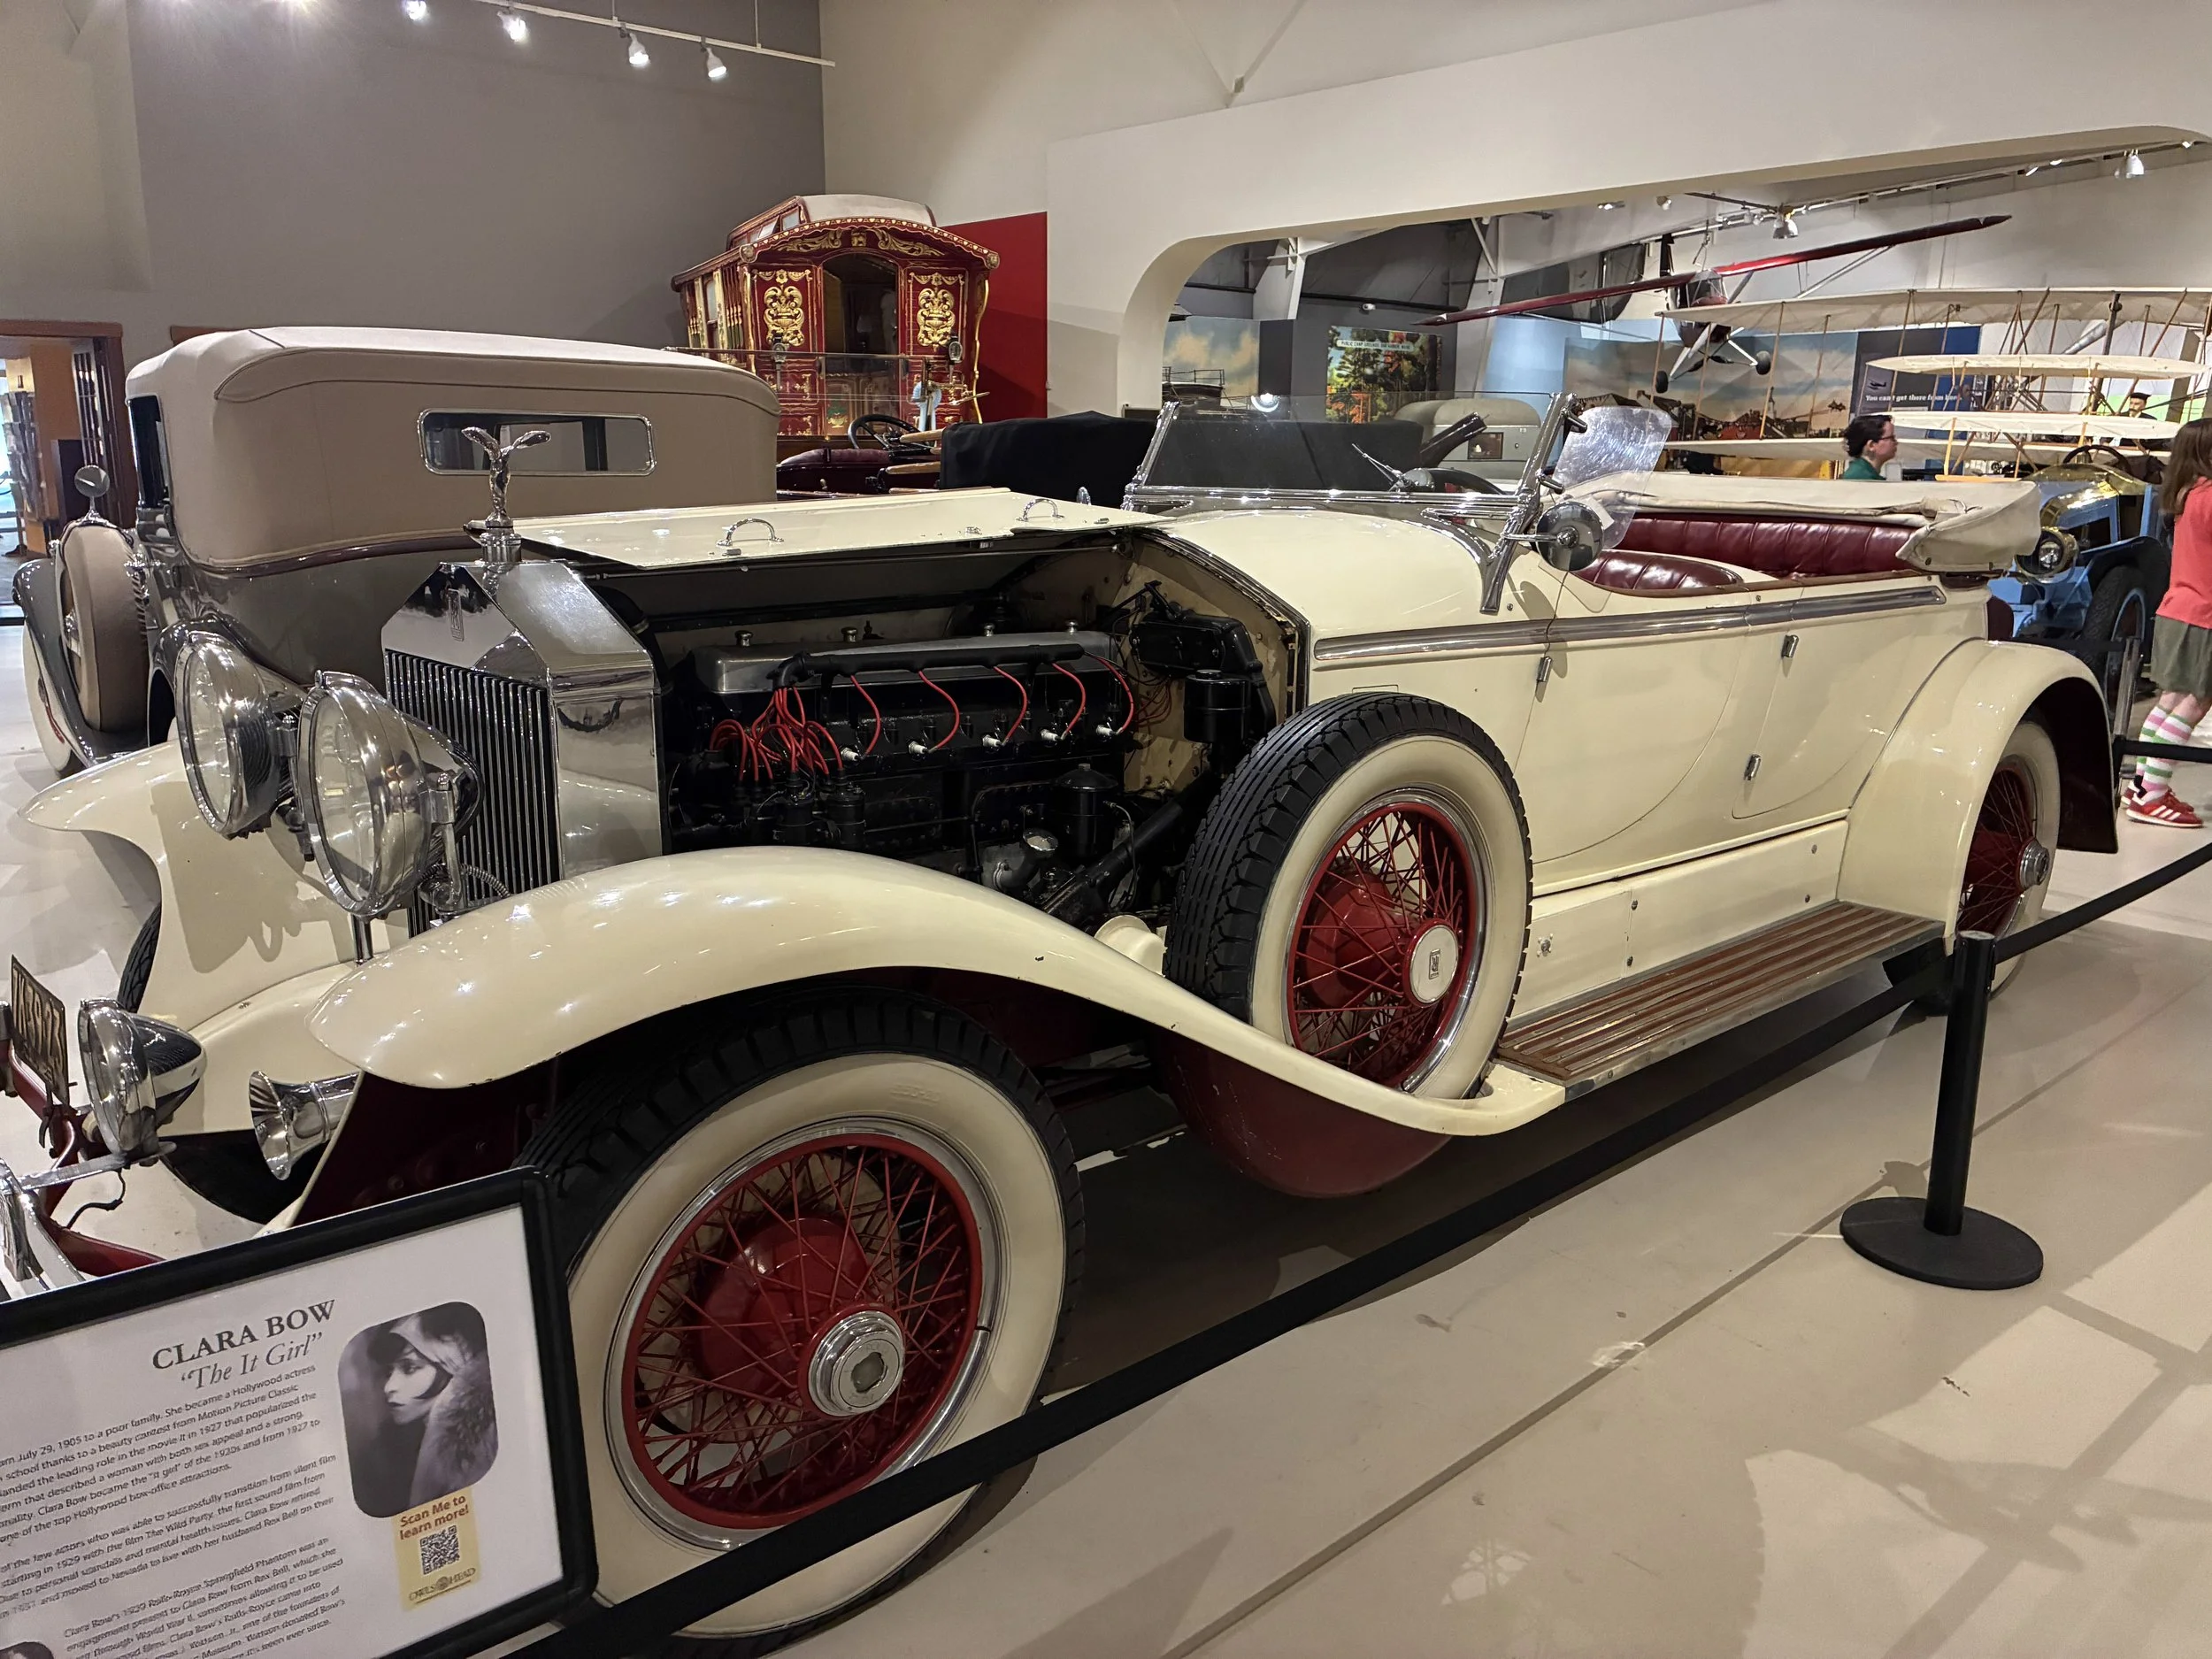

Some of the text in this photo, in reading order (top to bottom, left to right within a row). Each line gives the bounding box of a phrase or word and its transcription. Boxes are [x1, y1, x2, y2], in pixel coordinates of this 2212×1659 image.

[152, 1299, 335, 1370] CLARA BOW
[240, 1354, 259, 1376] It
[0, 1457, 14, 1467] orn
[18, 1450, 36, 1462] July
[58, 1436, 81, 1449] 1905
[105, 1424, 128, 1437] poor
[165, 1407, 182, 1417] She
[185, 1394, 222, 1410] became
[233, 1374, 281, 1395] Hollywood
[285, 1365, 315, 1379] actress
[6, 1463, 39, 1480] school
[42, 1455, 74, 1469] thanks
[98, 1438, 132, 1452] beauty
[134, 1425, 170, 1441] contest
[173, 1417, 196, 1429] from
[198, 1406, 231, 1421] Motion
[234, 1395, 265, 1409] Picture
[268, 1385, 298, 1399] Classic
[37, 1476, 54, 1486] the
[57, 1464, 94, 1479] leading
[96, 1456, 115, 1468] role
[129, 1448, 145, 1457] the
[147, 1438, 177, 1451] movie
[200, 1422, 221, 1435] 1927
[225, 1416, 242, 1427] that
[246, 1396, 300, 1422] popularized
[25, 1494, 44, 1505] that
[47, 1476, 96, 1498] described
[107, 1463, 142, 1479] woman
[145, 1455, 166, 1466] with
[169, 1447, 191, 1459] both
[244, 1423, 263, 1434] and
[38, 1503, 63, 1516] Clara
[66, 1496, 86, 1507] Bow
[89, 1483, 128, 1500] became
[131, 1477, 147, 1486] the
[184, 1459, 193, 1469] of
[196, 1455, 211, 1465] the
[242, 1438, 260, 1449] and
[263, 1432, 284, 1443] from
[270, 1471, 291, 1482] from
[294, 1461, 317, 1474] silent
[319, 1455, 336, 1465] film
[22, 1525, 31, 1536] of
[34, 1522, 50, 1532] the
[73, 1495, 127, 1520] Hollywood
[218, 1505, 233, 1515] the
[254, 1486, 282, 1502] sound
[285, 1481, 302, 1492] film
[303, 1473, 325, 1485] from
[400, 1495, 466, 1528] Scan Me to
[400, 1503, 470, 1540] learn more!
